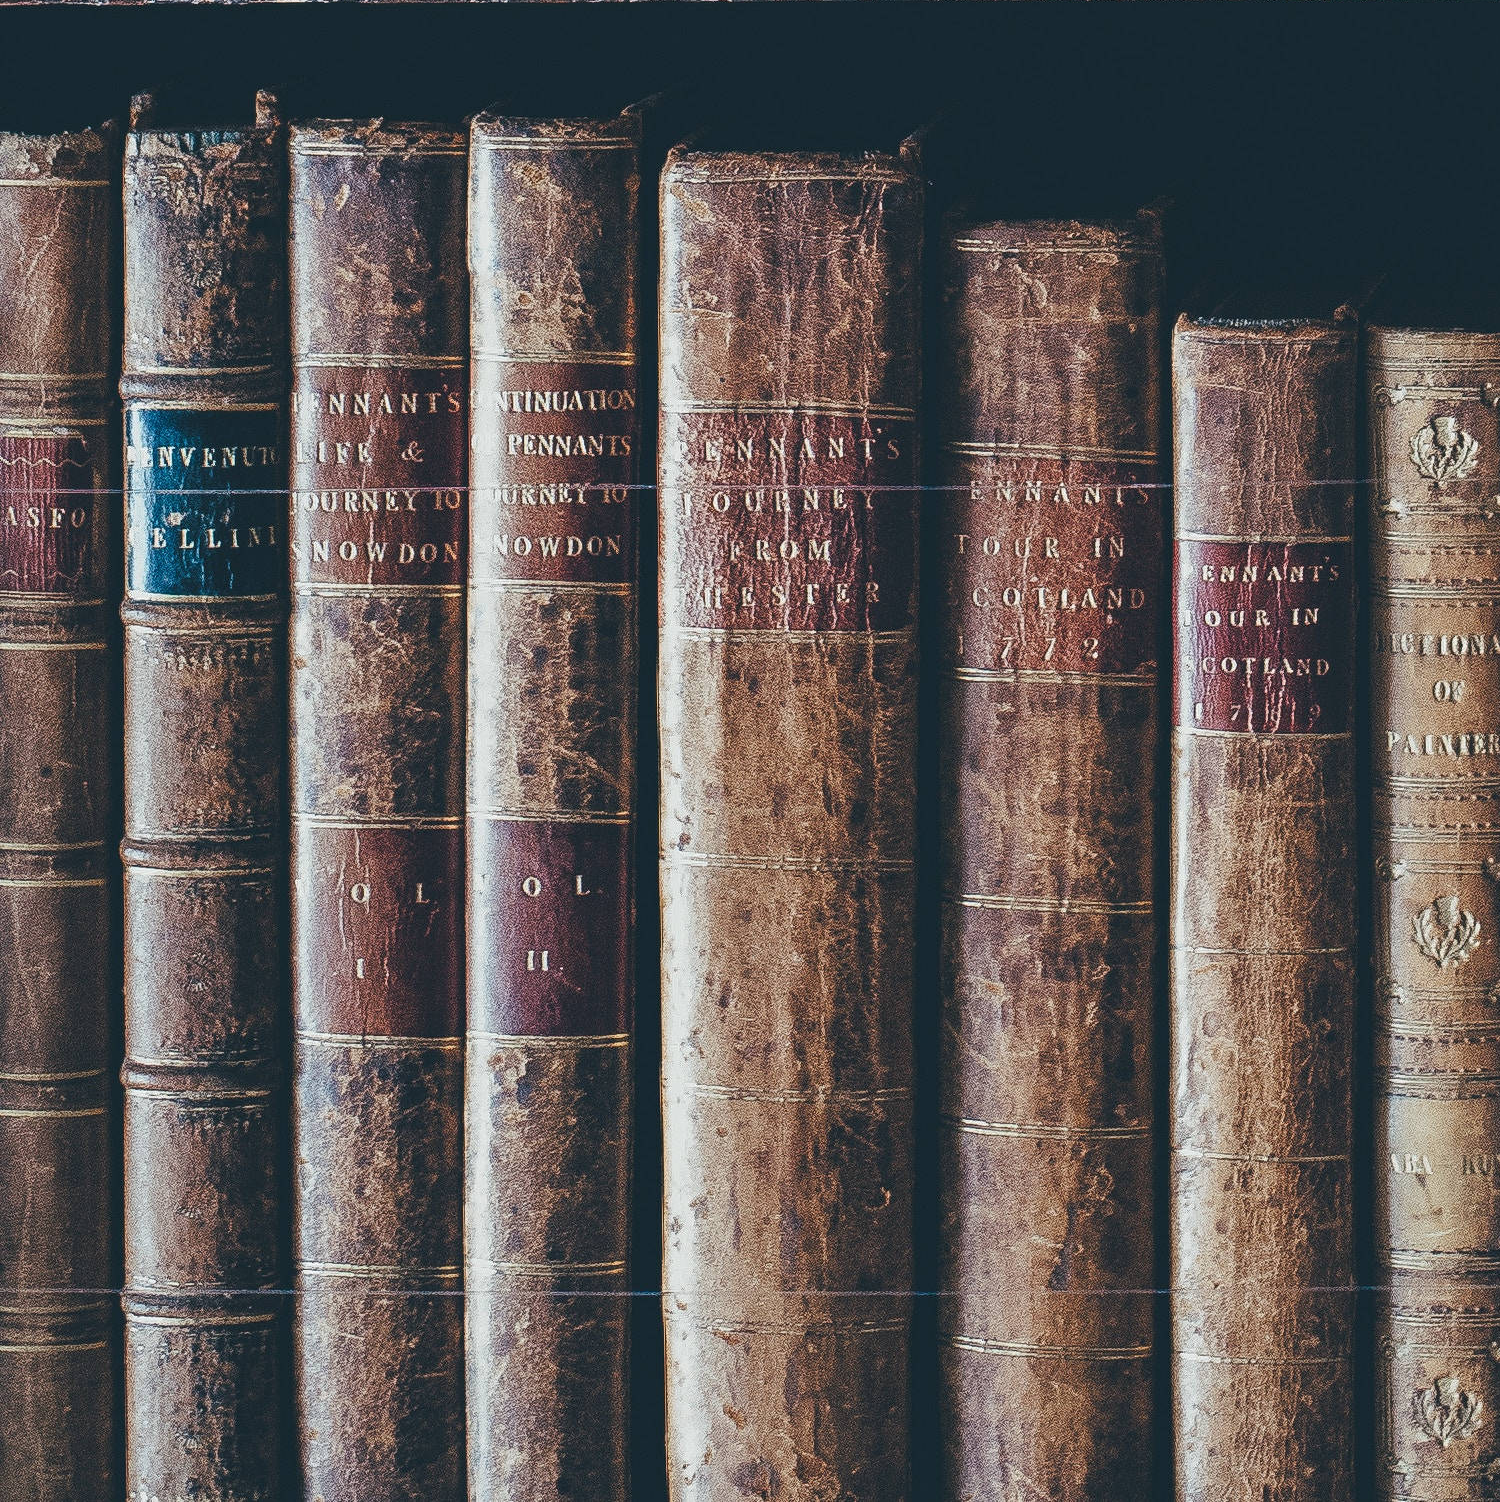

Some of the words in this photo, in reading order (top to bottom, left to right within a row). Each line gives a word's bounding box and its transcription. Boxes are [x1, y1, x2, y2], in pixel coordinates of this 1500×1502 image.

[471, 388, 636, 414] CNTINUATION
[297, 440, 373, 466] LIFE
[401, 440, 424, 463] &
[291, 490, 416, 515] JOURNEY
[433, 490, 461, 510] TO
[485, 481, 587, 505] OURNEY
[602, 484, 628, 505] TO
[682, 489, 874, 516] JOURNEY
[969, 475, 1150, 506] ENNANT'S
[132, 525, 275, 550] ELLINI
[484, 535, 622, 559] NOWDON
[953, 534, 1061, 558] TOUR
[1093, 534, 1125, 558] IN
[291, 541, 459, 565] SNOWDON
[730, 539, 831, 563] FROM
[688, 582, 880, 609] HESTER
[1183, 608, 1270, 629] TOUR
[1292, 607, 1319, 627] IN
[957, 637, 1100, 662] 1772
[1432, 679, 1466, 703] OF
